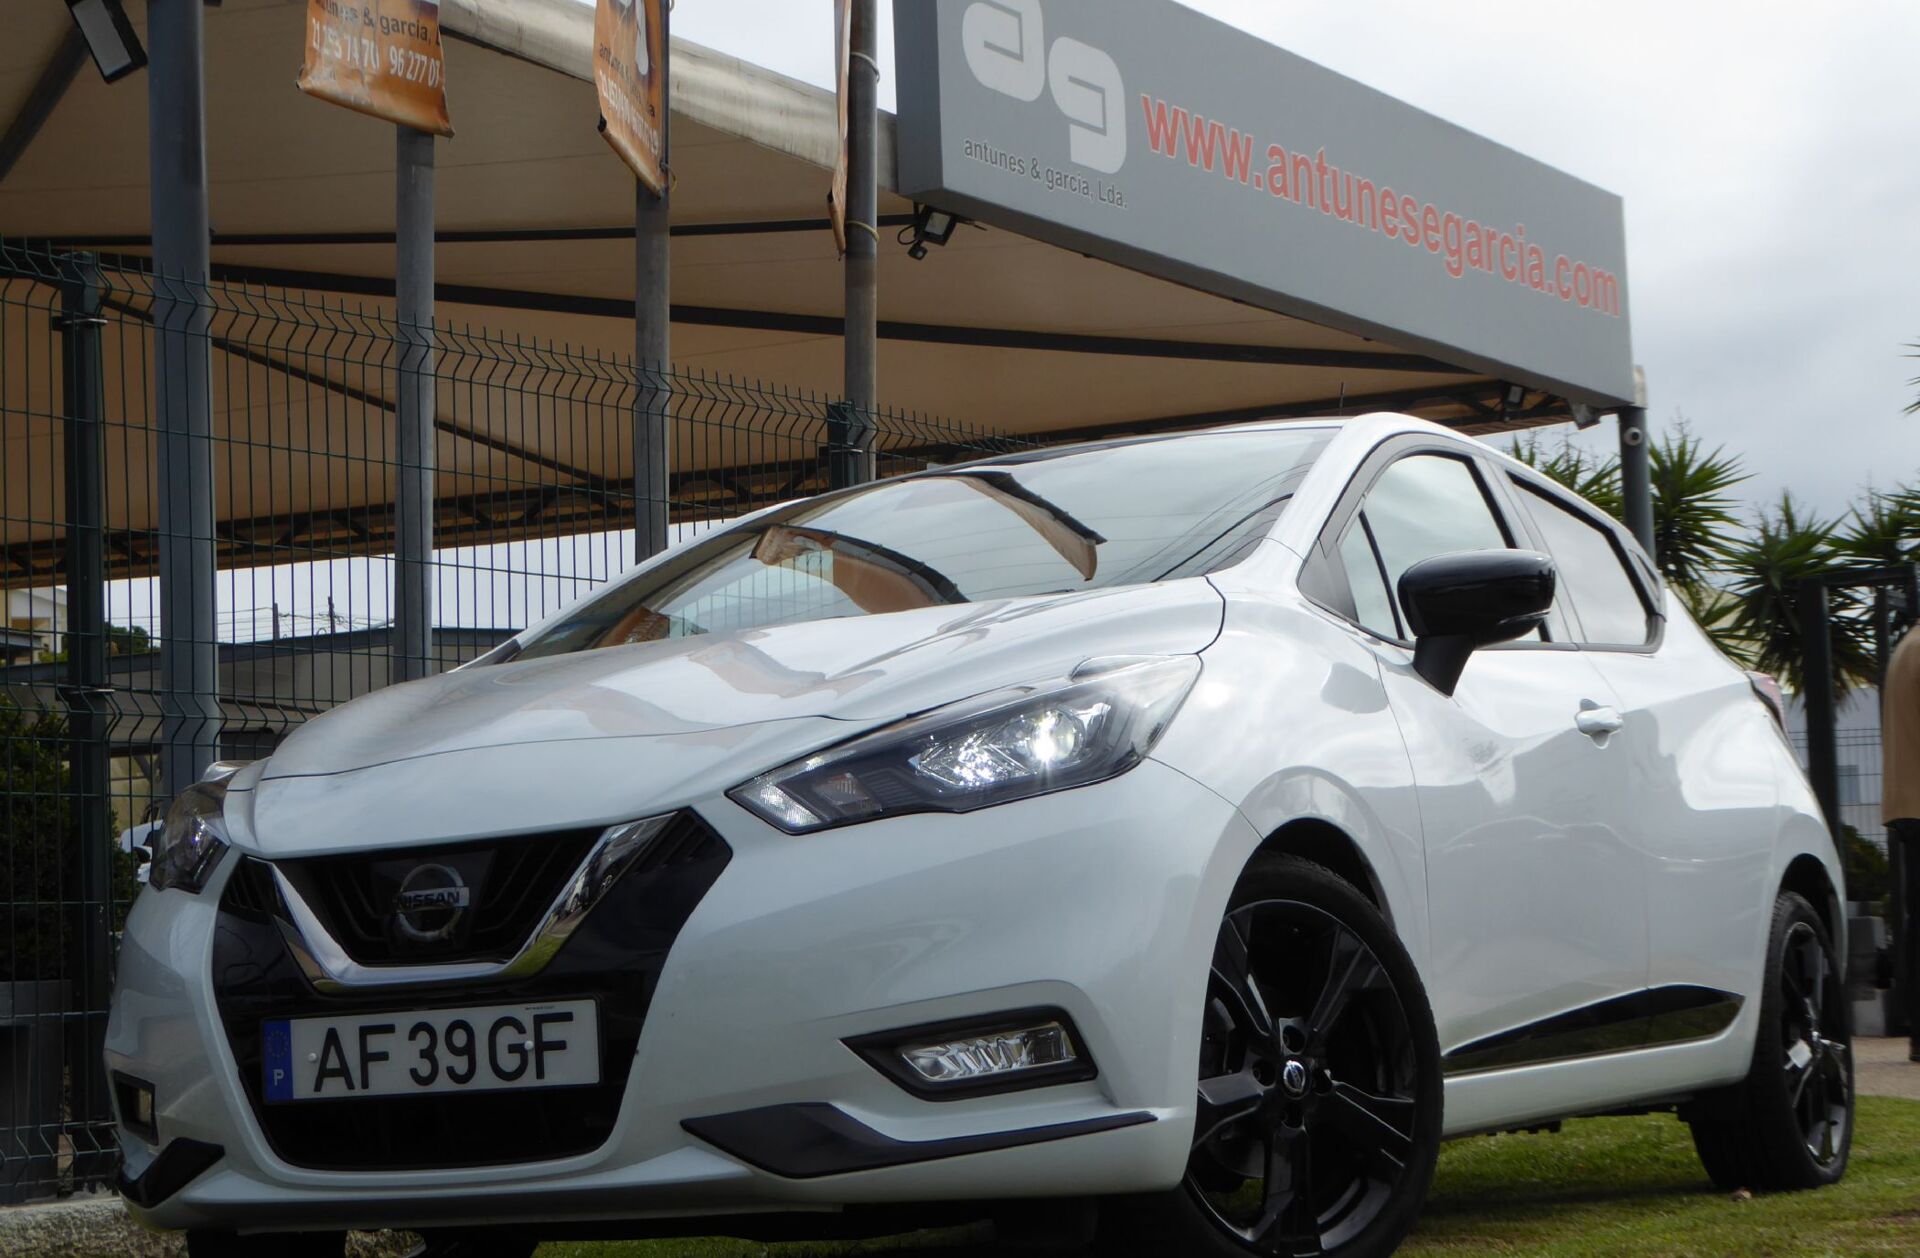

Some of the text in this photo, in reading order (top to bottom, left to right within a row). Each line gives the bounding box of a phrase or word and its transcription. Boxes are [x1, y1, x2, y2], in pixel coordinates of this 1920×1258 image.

[964, 138, 1128, 209] antunes & garcia, Lda.
[1141, 94, 1621, 317] www.antunesegarcia.com
[400, 890, 461, 910] NISSAN
[273, 1069, 285, 1086] P
